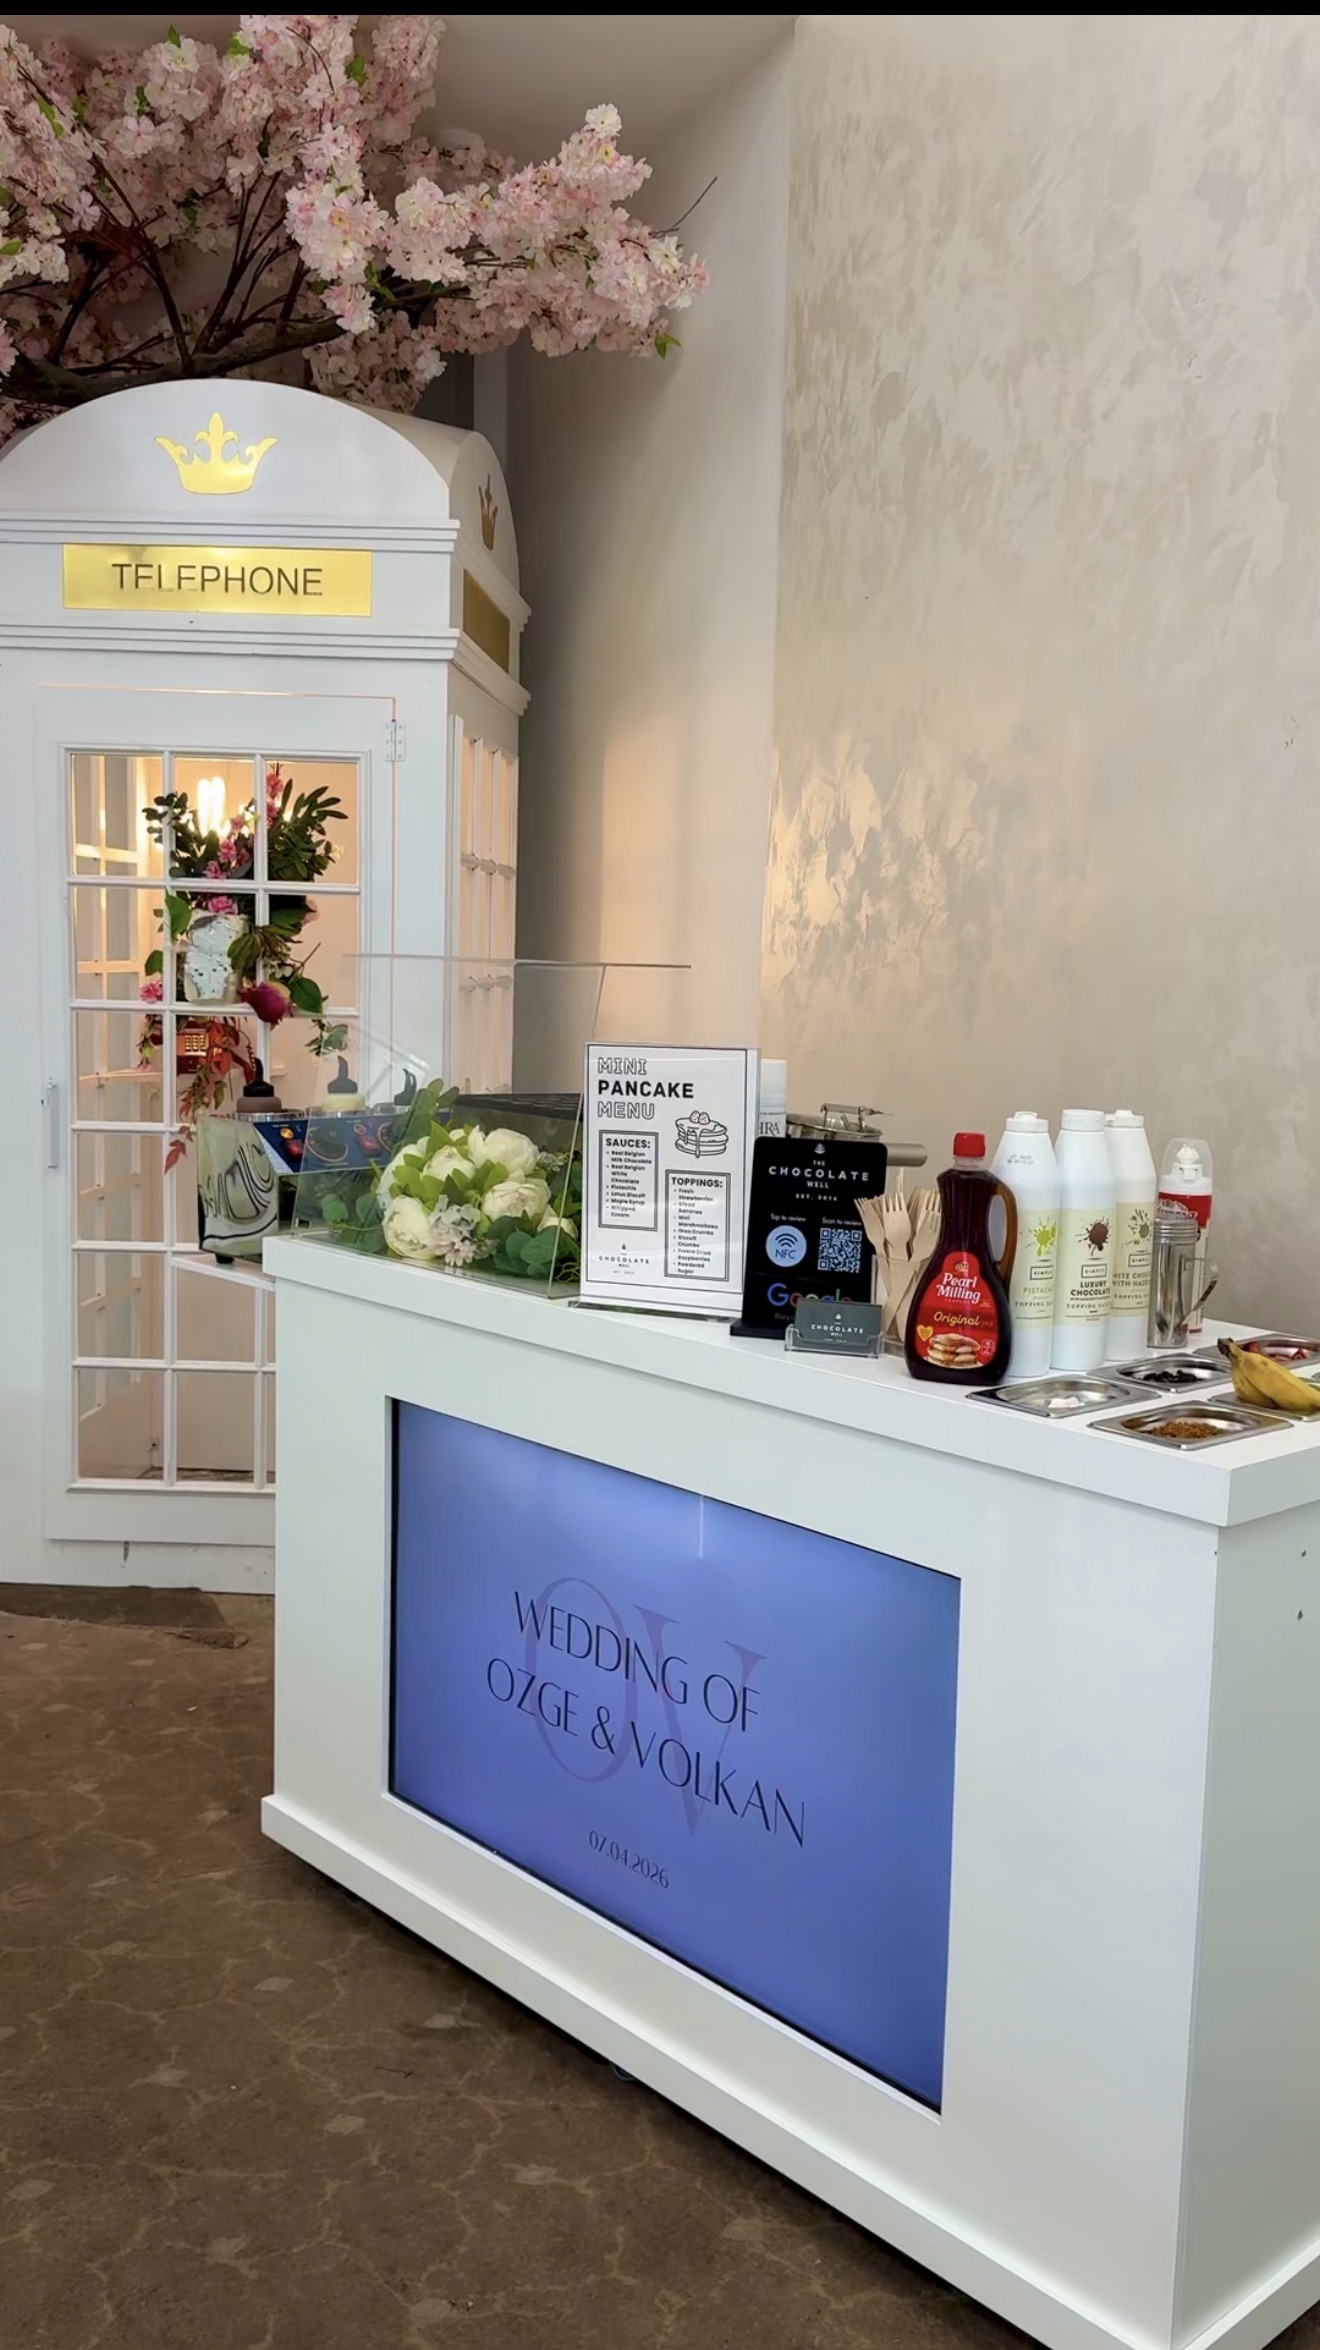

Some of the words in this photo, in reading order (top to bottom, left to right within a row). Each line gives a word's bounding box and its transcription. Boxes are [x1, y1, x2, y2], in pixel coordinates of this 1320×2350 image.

[111, 562, 323, 597] TELEPHONE
[597, 1057, 648, 1076] MINI
[598, 1079, 694, 1099] PANCAKE
[597, 1101, 656, 1121] MENU
[605, 1138, 651, 1149] SAUCES:
[768, 1165, 869, 1181] CHOCOLATE
[671, 1177, 723, 1188] TOPPINGS:
[806, 1180, 829, 1189] WELL
[822, 1217, 836, 1225] Scan
[598, 1255, 649, 1264] CHOCOLATE
[775, 1249, 797, 1259] NFC
[942, 1272, 978, 1288] Pearl
[1080, 1280, 1107, 1289] LUXURY
[936, 1283, 981, 1304] Milling
[933, 1310, 981, 1327] Original
[811, 1323, 864, 1334] CHOCOLATE
[513, 1591, 689, 1705] WEDDING
[703, 1673, 760, 1732] OF
[487, 1658, 580, 1737] OZGE
[591, 1706, 617, 1755] &
[630, 1720, 805, 1848] VOLKAN
[588, 1830, 670, 1889] 07.04.2026
